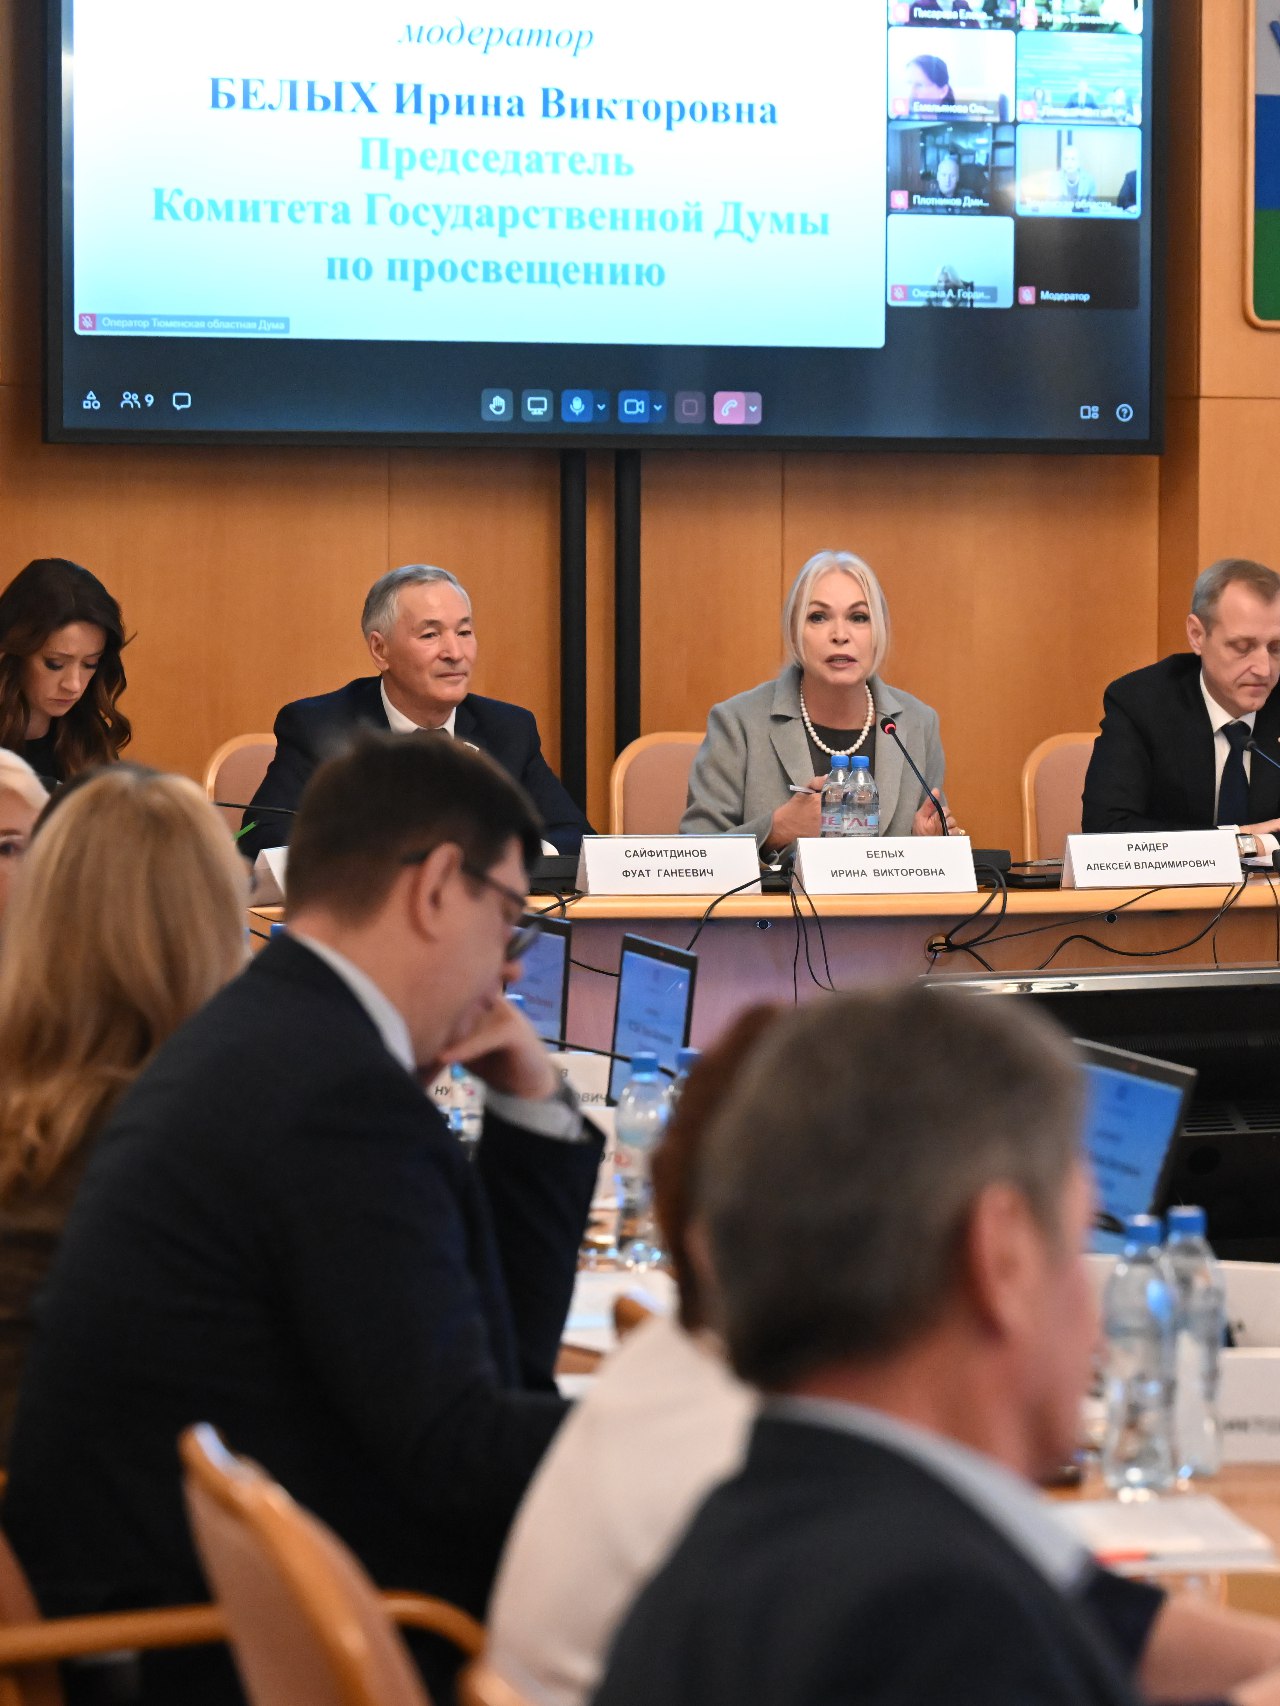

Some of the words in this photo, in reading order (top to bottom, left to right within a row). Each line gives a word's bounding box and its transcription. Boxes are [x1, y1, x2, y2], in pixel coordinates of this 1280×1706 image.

[397, 16, 594, 56] модератор
[209, 76, 380, 114] БЕЛЫХ
[395, 83, 525, 125] Ирина
[541, 87, 778, 131] Викторовна
[360, 136, 635, 180] Председатель
[153, 187, 352, 225] Комитета
[364, 192, 704, 238] Государственной
[713, 200, 830, 243] Думы
[325, 256, 373, 281] по
[387, 257, 666, 291] просвещению
[912, 288, 947, 299] Оксана
[1040, 291, 1090, 302] Модератор
[102, 316, 149, 328] Оператор
[152, 318, 205, 328] Тюменская
[207, 319, 257, 330] областная
[258, 321, 285, 332] Дума
[1127, 841, 1169, 852] РАЙДЕР
[624, 847, 707, 859] САЙФИТДИНОВ
[866, 850, 905, 859] БЕЛЫХ
[1086, 860, 1131, 871] АЛЕКСЕЙ
[1134, 859, 1216, 871] ВЛАДИМИРОВИЧ
[622, 868, 651, 878] ФУАТ
[657, 868, 714, 878] ГАНЕЕВИЧ
[831, 869, 868, 878] ИРИНА
[873, 867, 946, 877] ВИКТОРОВНА
